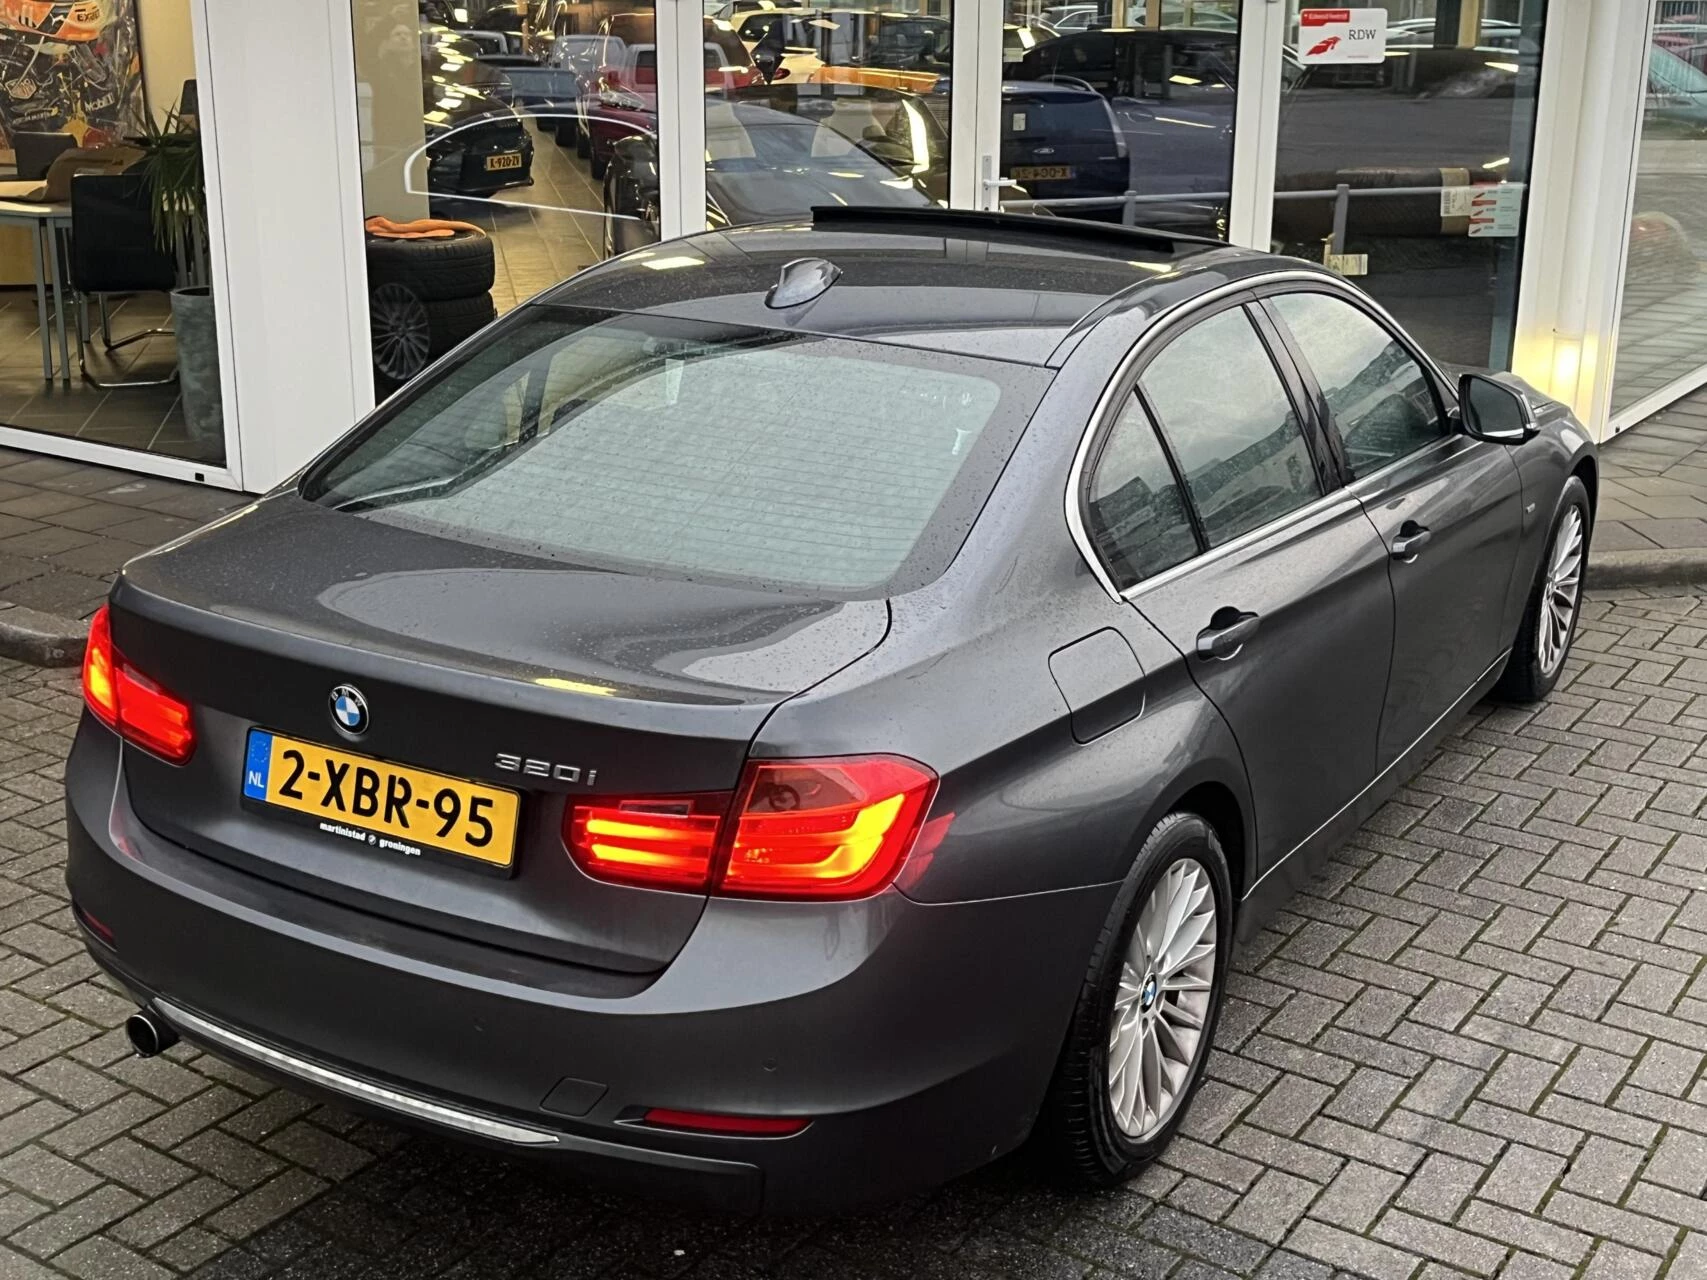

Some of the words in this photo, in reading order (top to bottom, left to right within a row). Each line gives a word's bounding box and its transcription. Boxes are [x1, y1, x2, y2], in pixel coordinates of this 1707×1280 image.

[1348, 29, 1376, 41] RDW
[494, 752, 597, 786] 320i
[248, 770, 264, 789] NL
[278, 749, 493, 848] 2-XBR-95
[319, 822, 366, 841] martinistad
[379, 839, 422, 856] groningen
